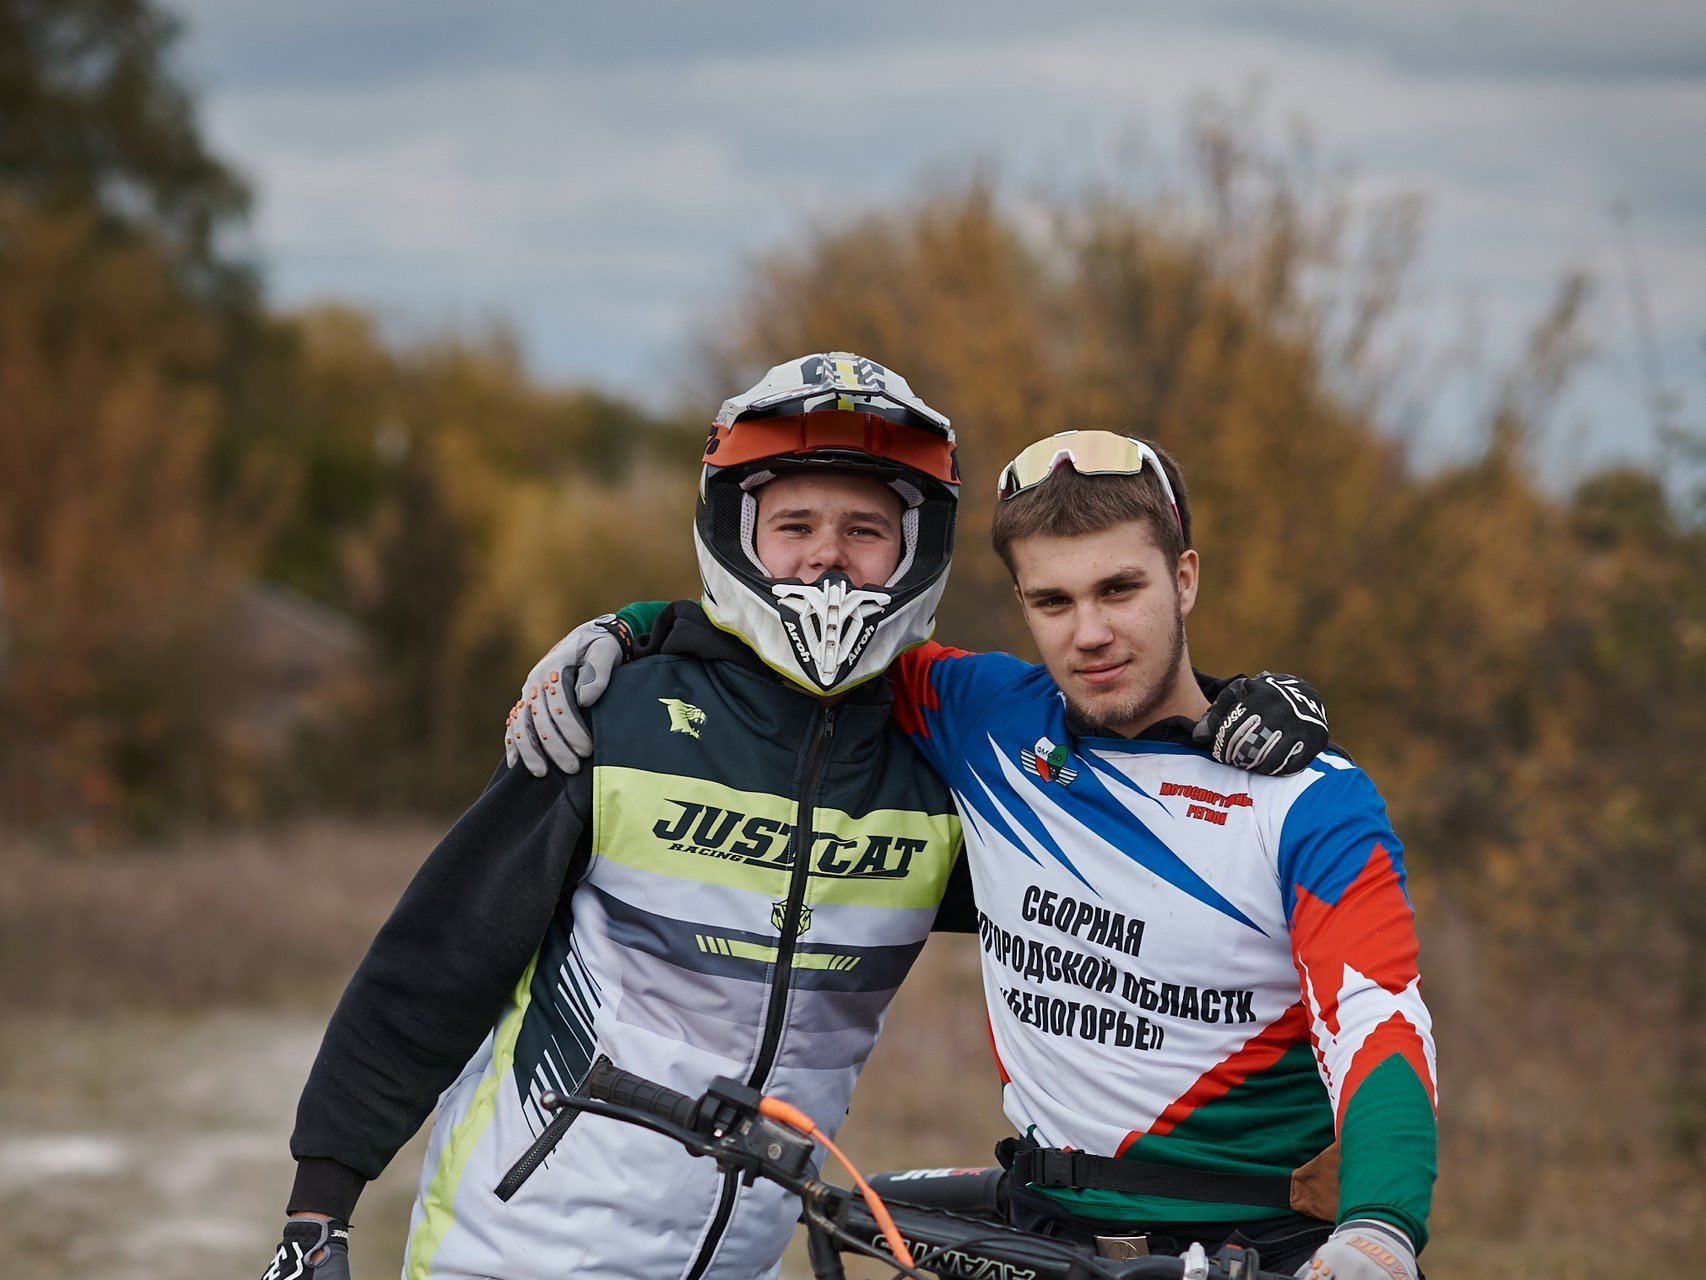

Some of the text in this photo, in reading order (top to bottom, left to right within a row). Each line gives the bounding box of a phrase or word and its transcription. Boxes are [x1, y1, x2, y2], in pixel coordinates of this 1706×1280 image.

[784, 620, 811, 663] Airoh
[848, 624, 875, 666] Airoh
[1186, 804, 1229, 826] РЕГИОН
[667, 842, 746, 863] RACING
[1021, 884, 1146, 958] СБОРНАЯ
[1120, 971, 1258, 1025] ОБЛАСТИ
